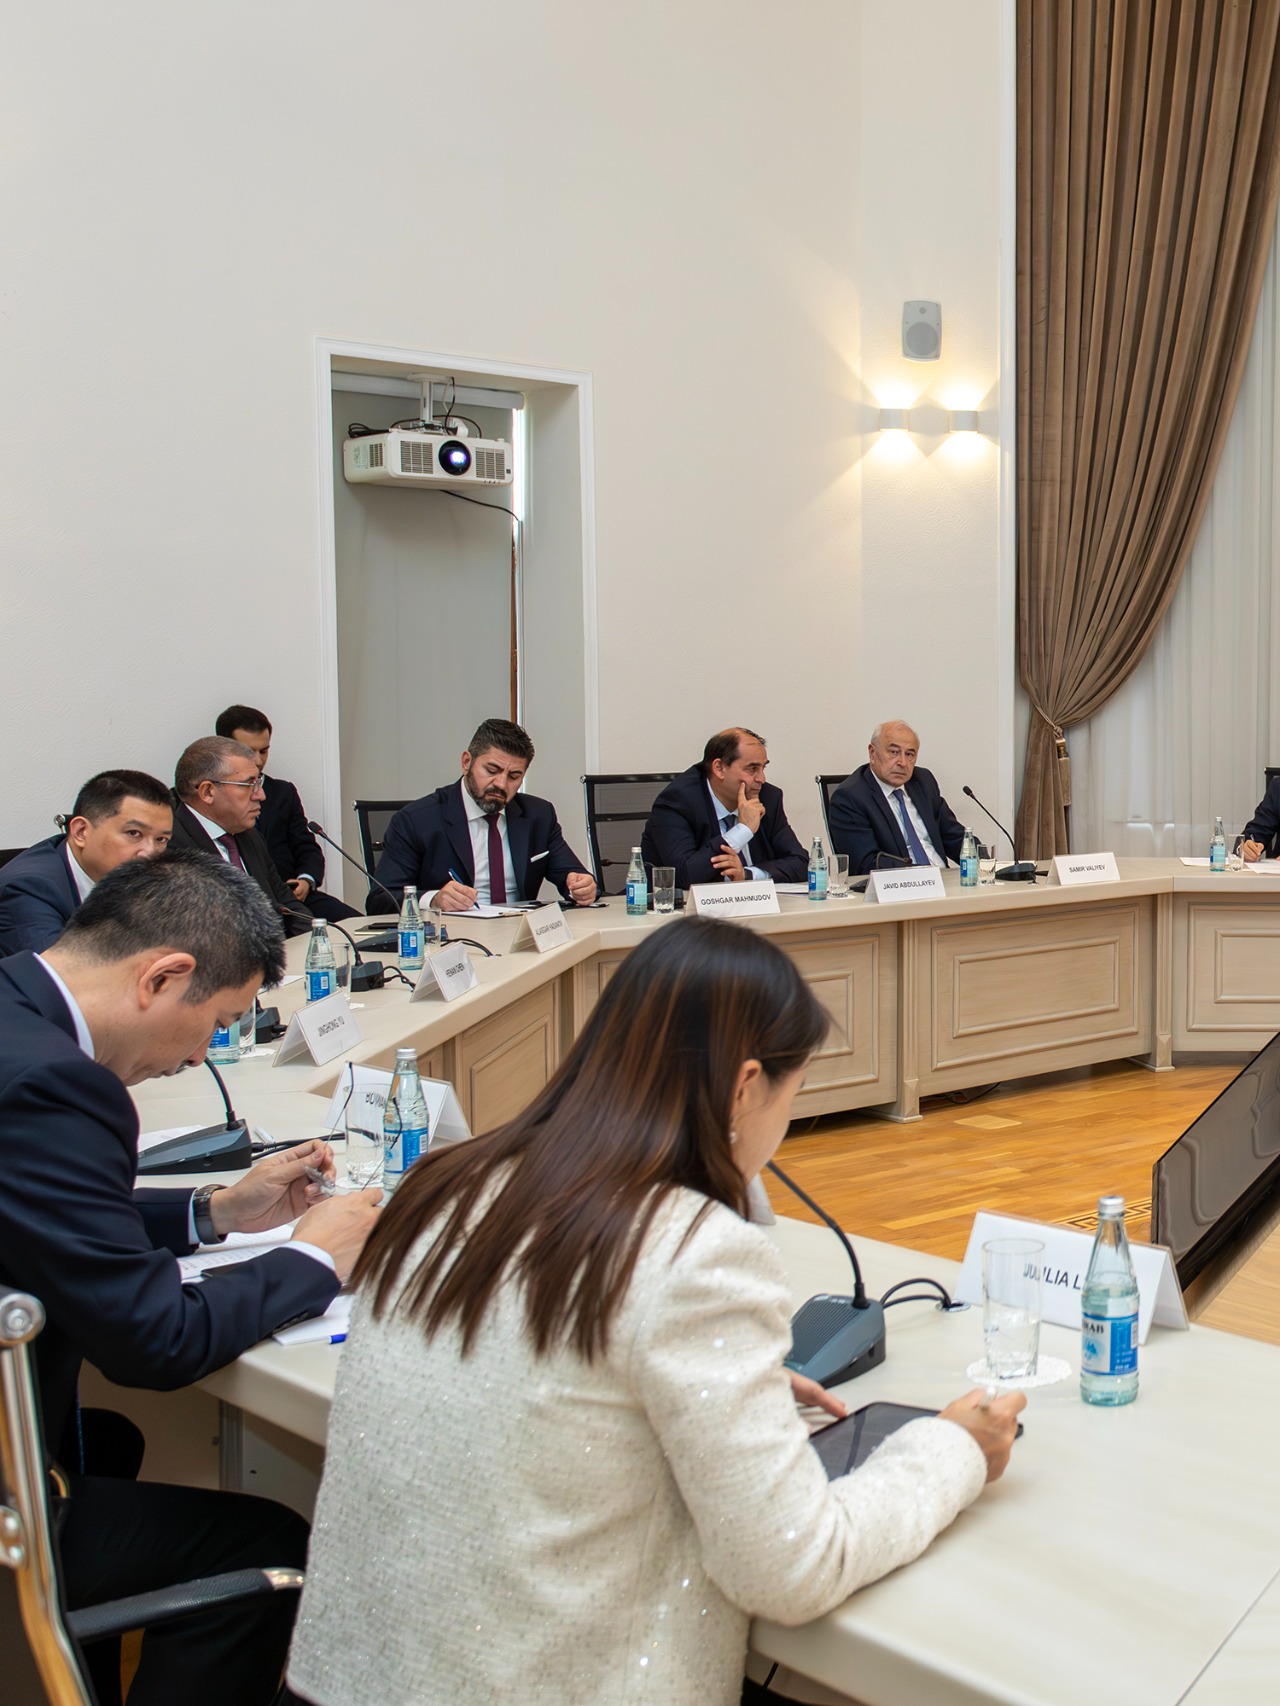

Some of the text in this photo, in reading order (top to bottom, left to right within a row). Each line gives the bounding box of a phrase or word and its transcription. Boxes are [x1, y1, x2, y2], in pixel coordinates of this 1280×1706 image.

[883, 879, 936, 890] JAVID ABDULLAYEV
[701, 894, 772, 905] GOSHGAR MAHMUDOV
